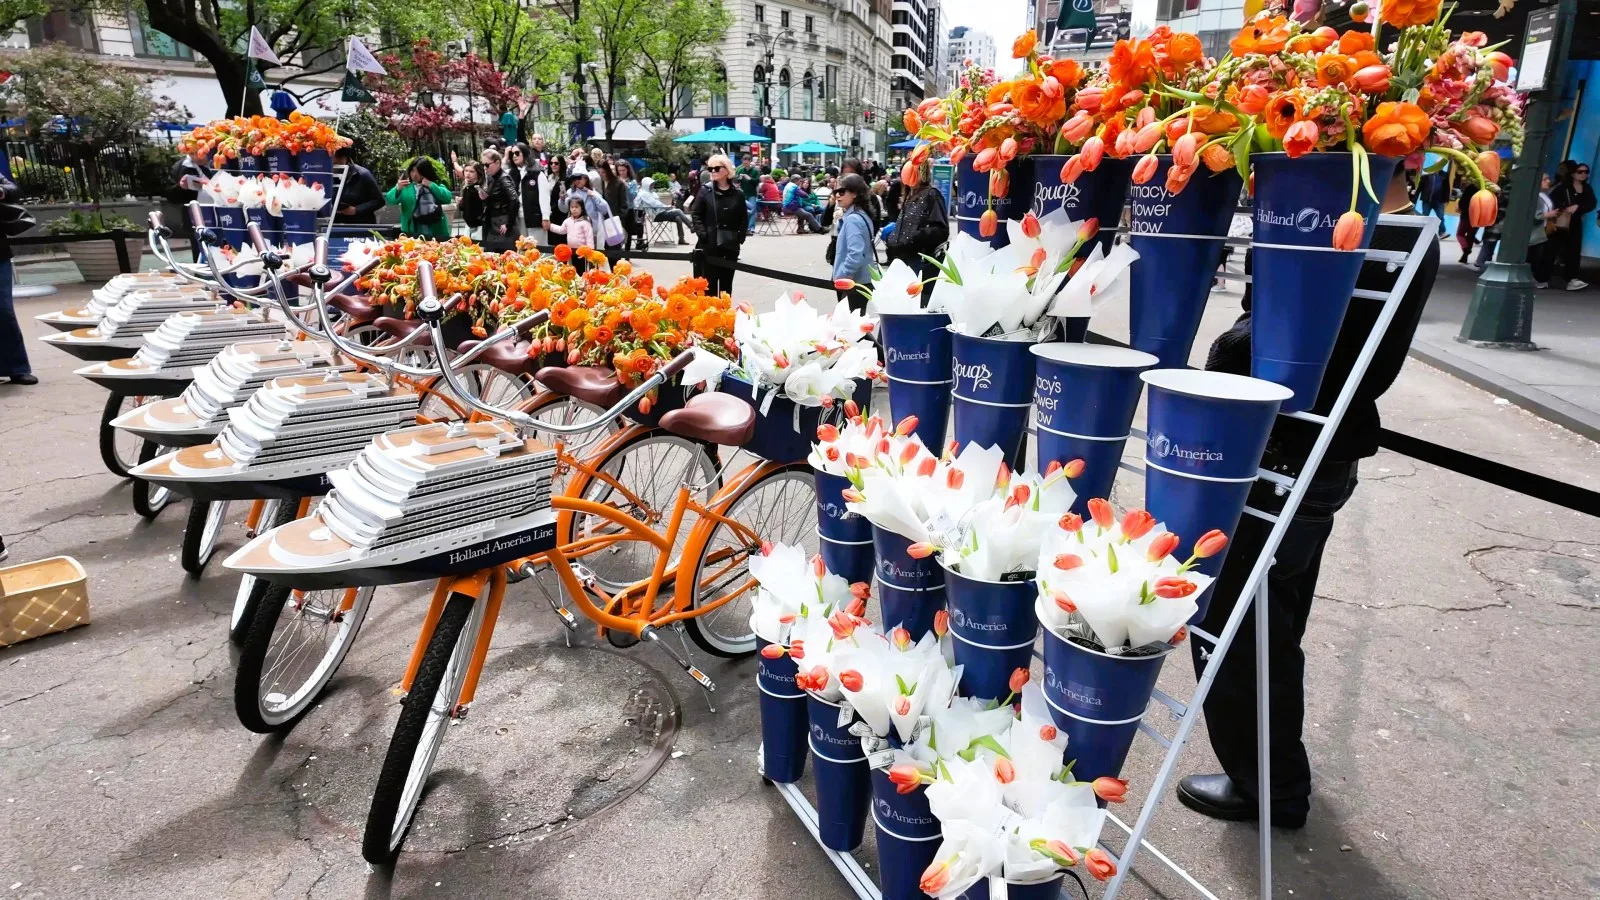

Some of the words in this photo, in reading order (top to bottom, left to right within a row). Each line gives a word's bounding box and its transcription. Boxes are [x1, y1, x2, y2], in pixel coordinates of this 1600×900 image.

[1132, 200, 1171, 216] flower
[1256, 208, 1294, 226] Holland
[1132, 218, 1163, 233] show
[897, 351, 930, 361] America
[1036, 375, 1062, 395] acy's
[1169, 443, 1223, 461] America
[449, 544, 490, 565] Holland
[492, 535, 531, 552] America
[533, 528, 554, 541] Line
[965, 618, 1008, 630] America
[765, 669, 796, 682] America
[1056, 680, 1102, 706] America
[824, 734, 861, 745] America
[891, 810, 933, 824] America
